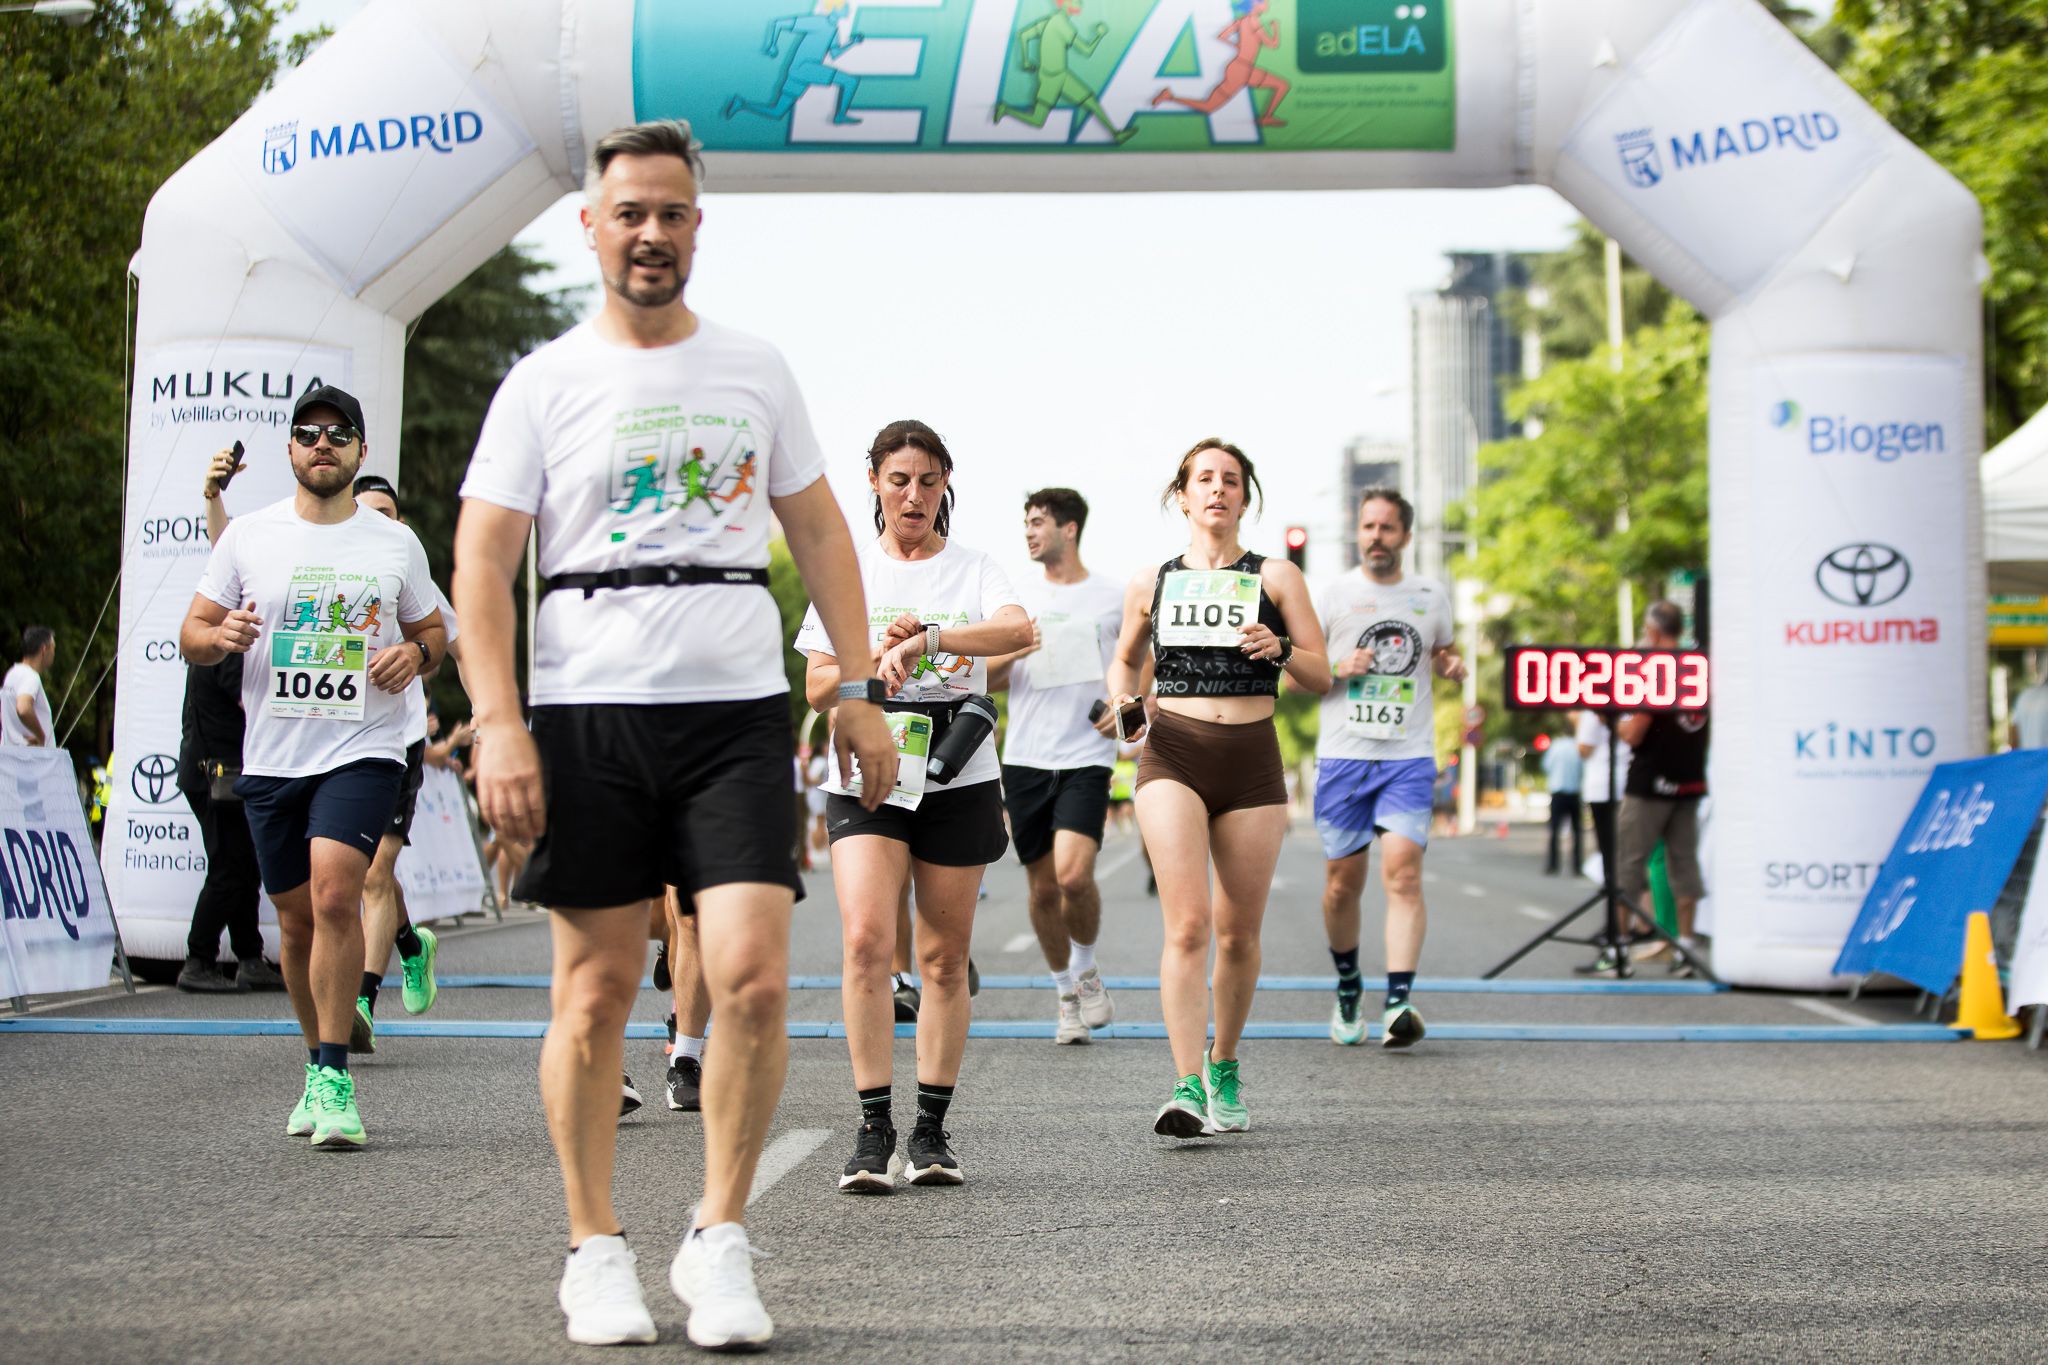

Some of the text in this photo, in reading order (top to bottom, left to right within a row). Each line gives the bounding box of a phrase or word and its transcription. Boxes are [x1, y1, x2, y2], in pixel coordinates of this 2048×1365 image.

[1315, 24, 1426, 57] adELA
[787, 0, 1263, 144] ELA
[310, 110, 484, 159] MADRID
[1670, 110, 1840, 170] MADRID
[616, 415, 750, 434] MADRID CON LA
[1808, 415, 1945, 462] Biogen
[291, 573, 378, 583] MADRID CON LA
[1183, 577, 1238, 598] ELA
[924, 613, 949, 622] CON
[1170, 604, 1245, 628] 1105
[289, 641, 345, 667] ELA
[275, 671, 358, 702] 1066
[1195, 680, 1248, 694] NIKE
[1360, 681, 1401, 700] ELA
[1355, 704, 1406, 726] 1163
[127, 819, 190, 844] Toyota
[125, 848, 207, 872] Financia
[0, 827, 90, 941] ADRID
[1764, 862, 1885, 890] SPORT
